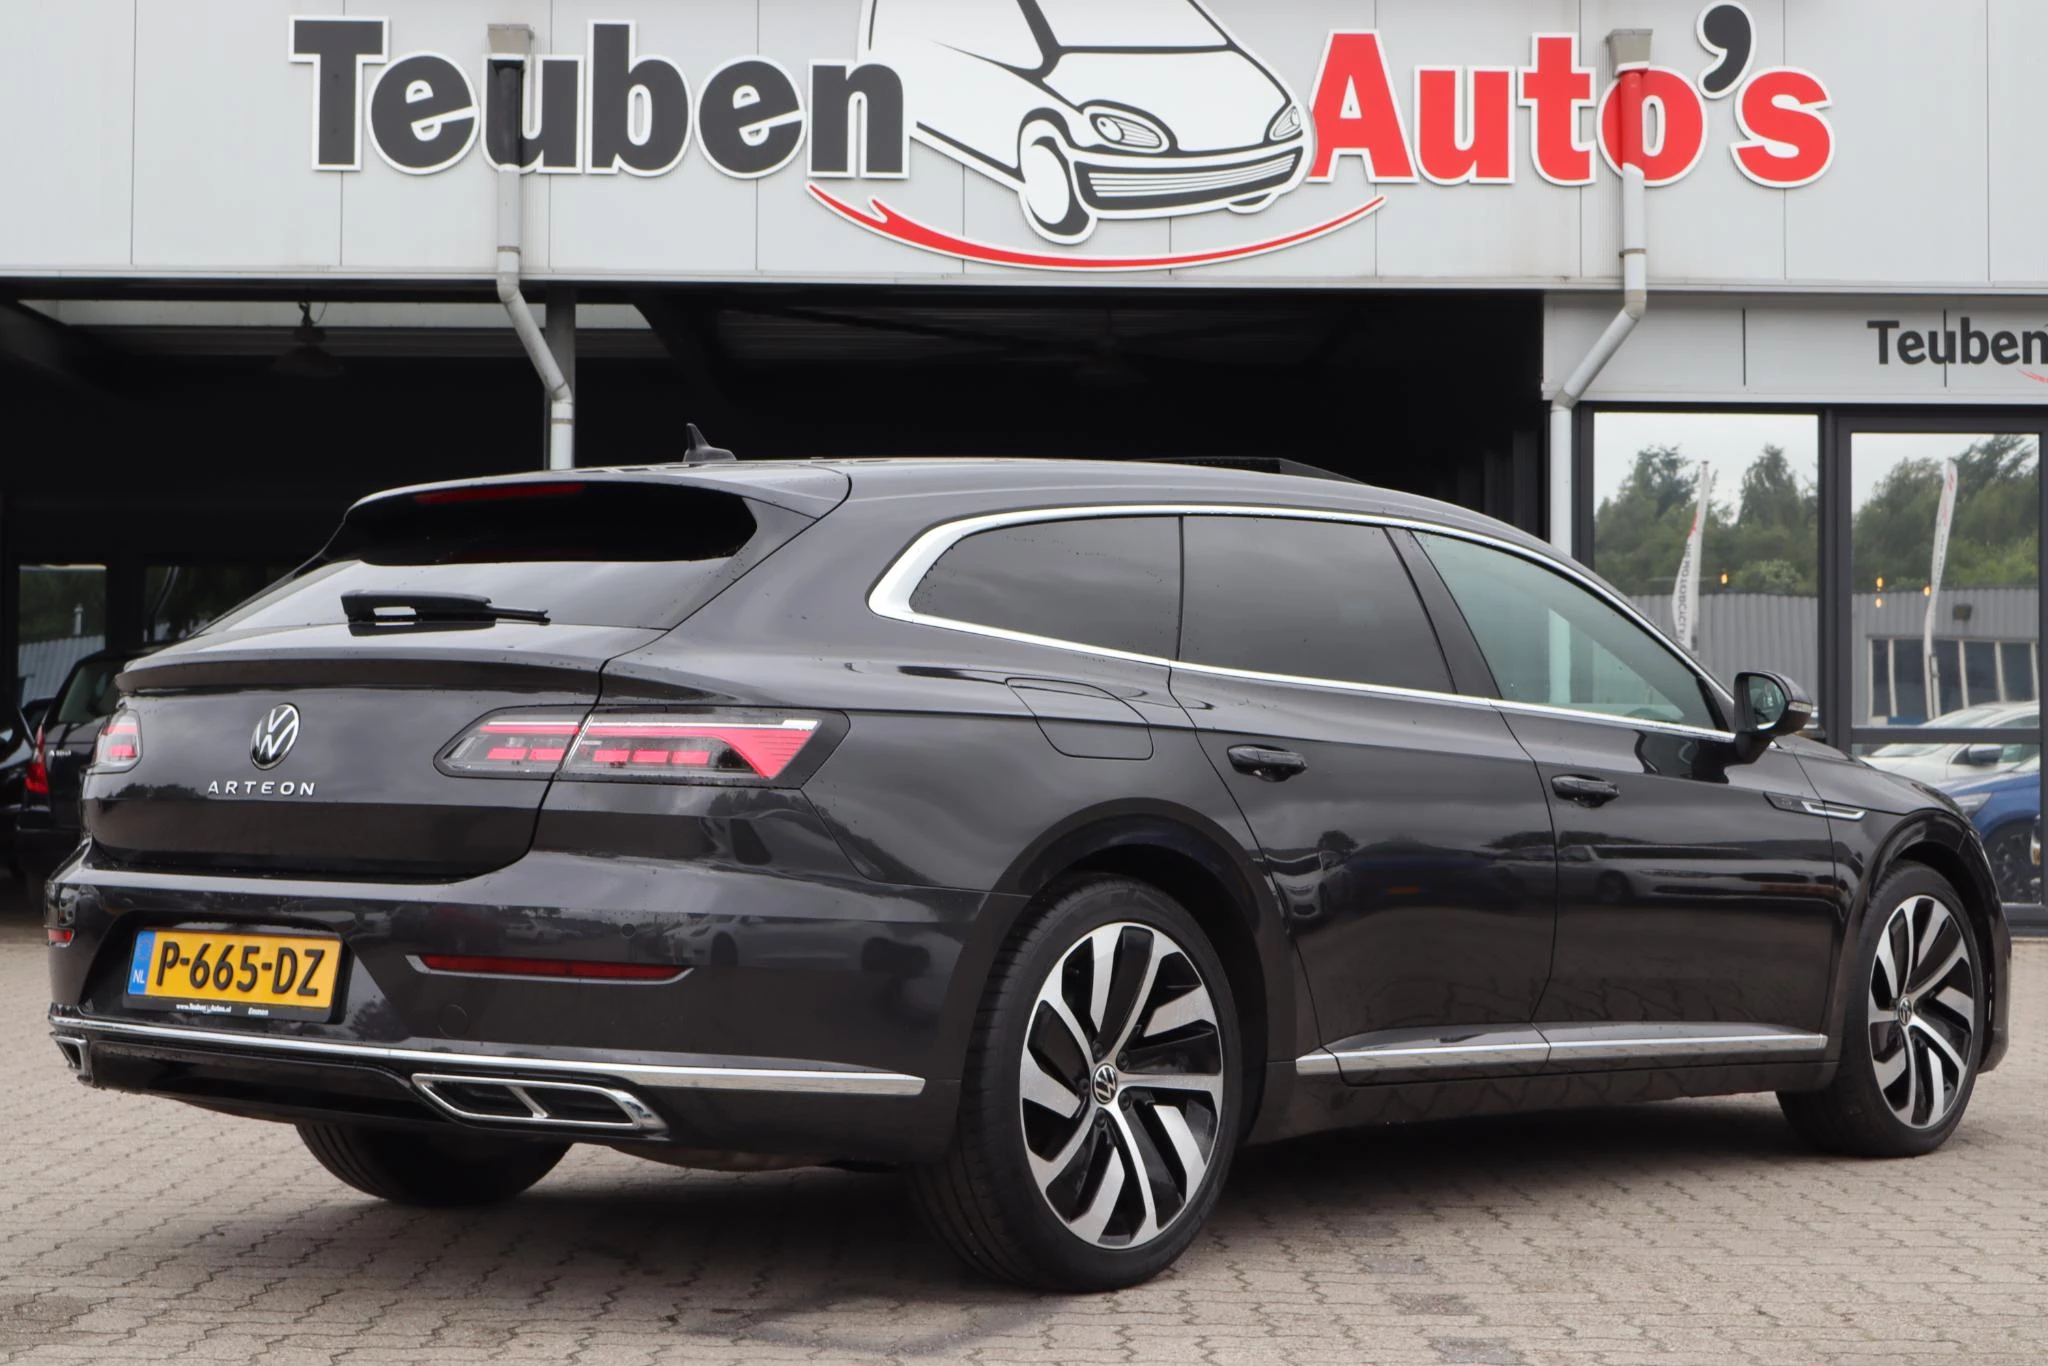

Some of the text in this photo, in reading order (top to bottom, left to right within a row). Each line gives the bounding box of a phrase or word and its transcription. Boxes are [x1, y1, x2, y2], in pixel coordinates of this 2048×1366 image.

[289, 1, 1834, 187] Teuben Auto's
[1867, 316, 2048, 365] Teuben
[208, 780, 316, 797] ARTEON
[132, 969, 146, 984] NL
[156, 940, 325, 998] P-665-DZ
